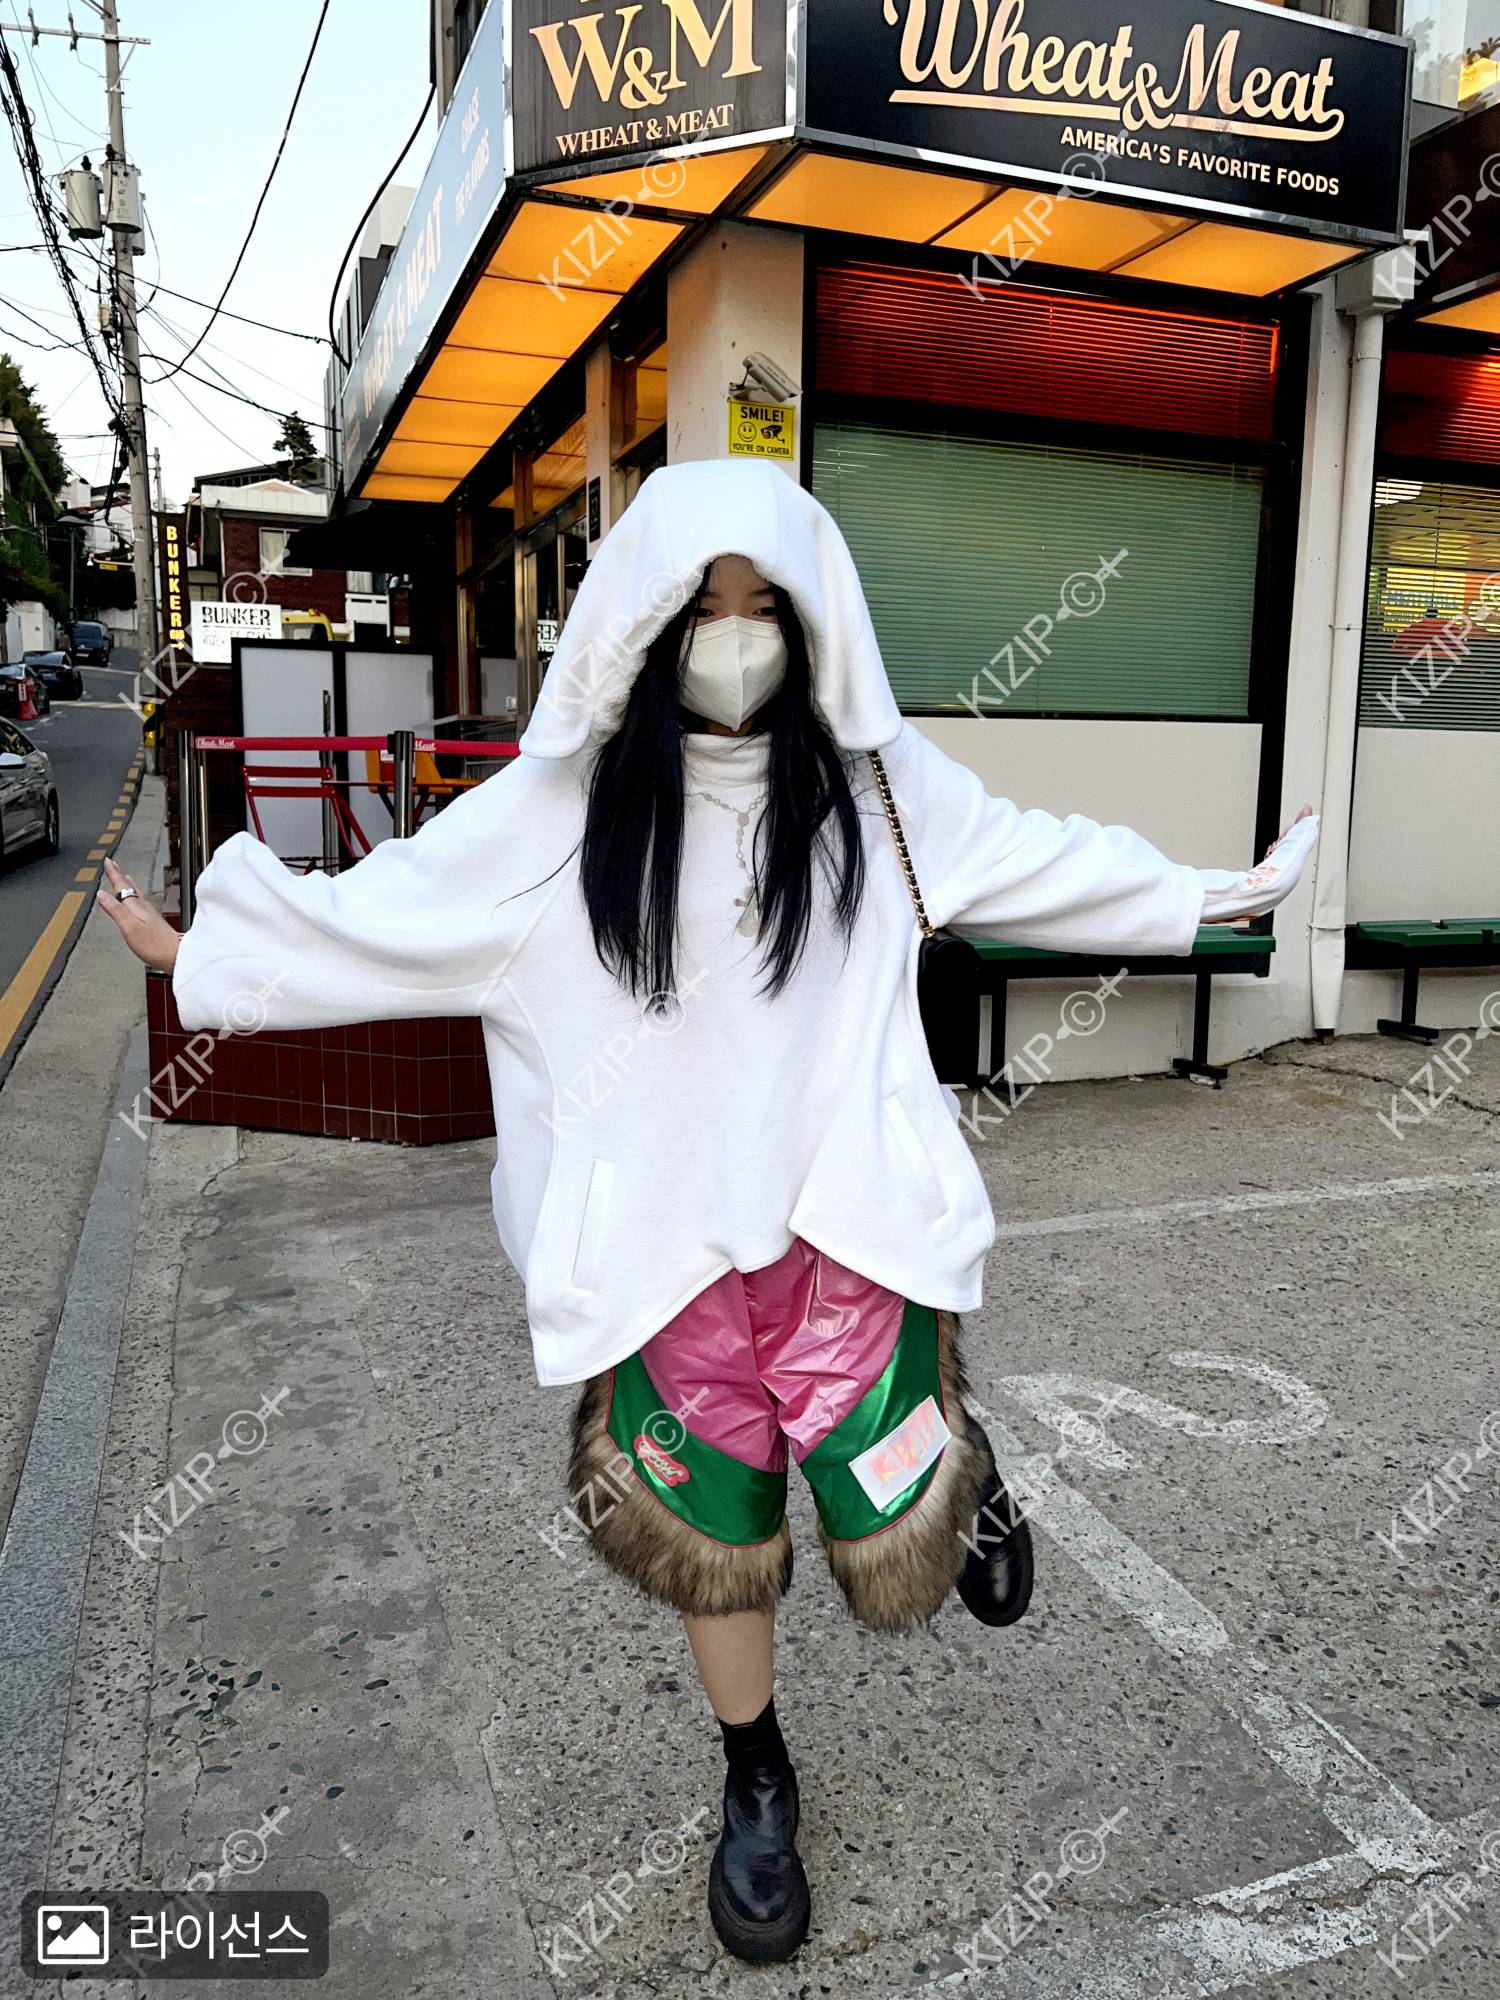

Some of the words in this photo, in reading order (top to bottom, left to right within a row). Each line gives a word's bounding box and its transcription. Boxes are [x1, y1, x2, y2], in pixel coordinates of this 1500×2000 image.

[555, 121, 644, 156] WHEAT
[645, 117, 663, 140] &
[665, 103, 735, 138] MEAT
[1060, 126, 1171, 164] AMERICA'S
[1177, 149, 1271, 183] FAVORITE
[1276, 168, 1339, 196] FOODS
[362, 304, 395, 419] WHEAT
[406, 184, 443, 325] MEAT
[740, 406, 785, 422] SMILE!
[756, 445, 765, 453] ON
[767, 446, 790, 455] CAMERA
[166, 525, 182, 628] BUNKER
[202, 606, 271, 626] BUNKER
